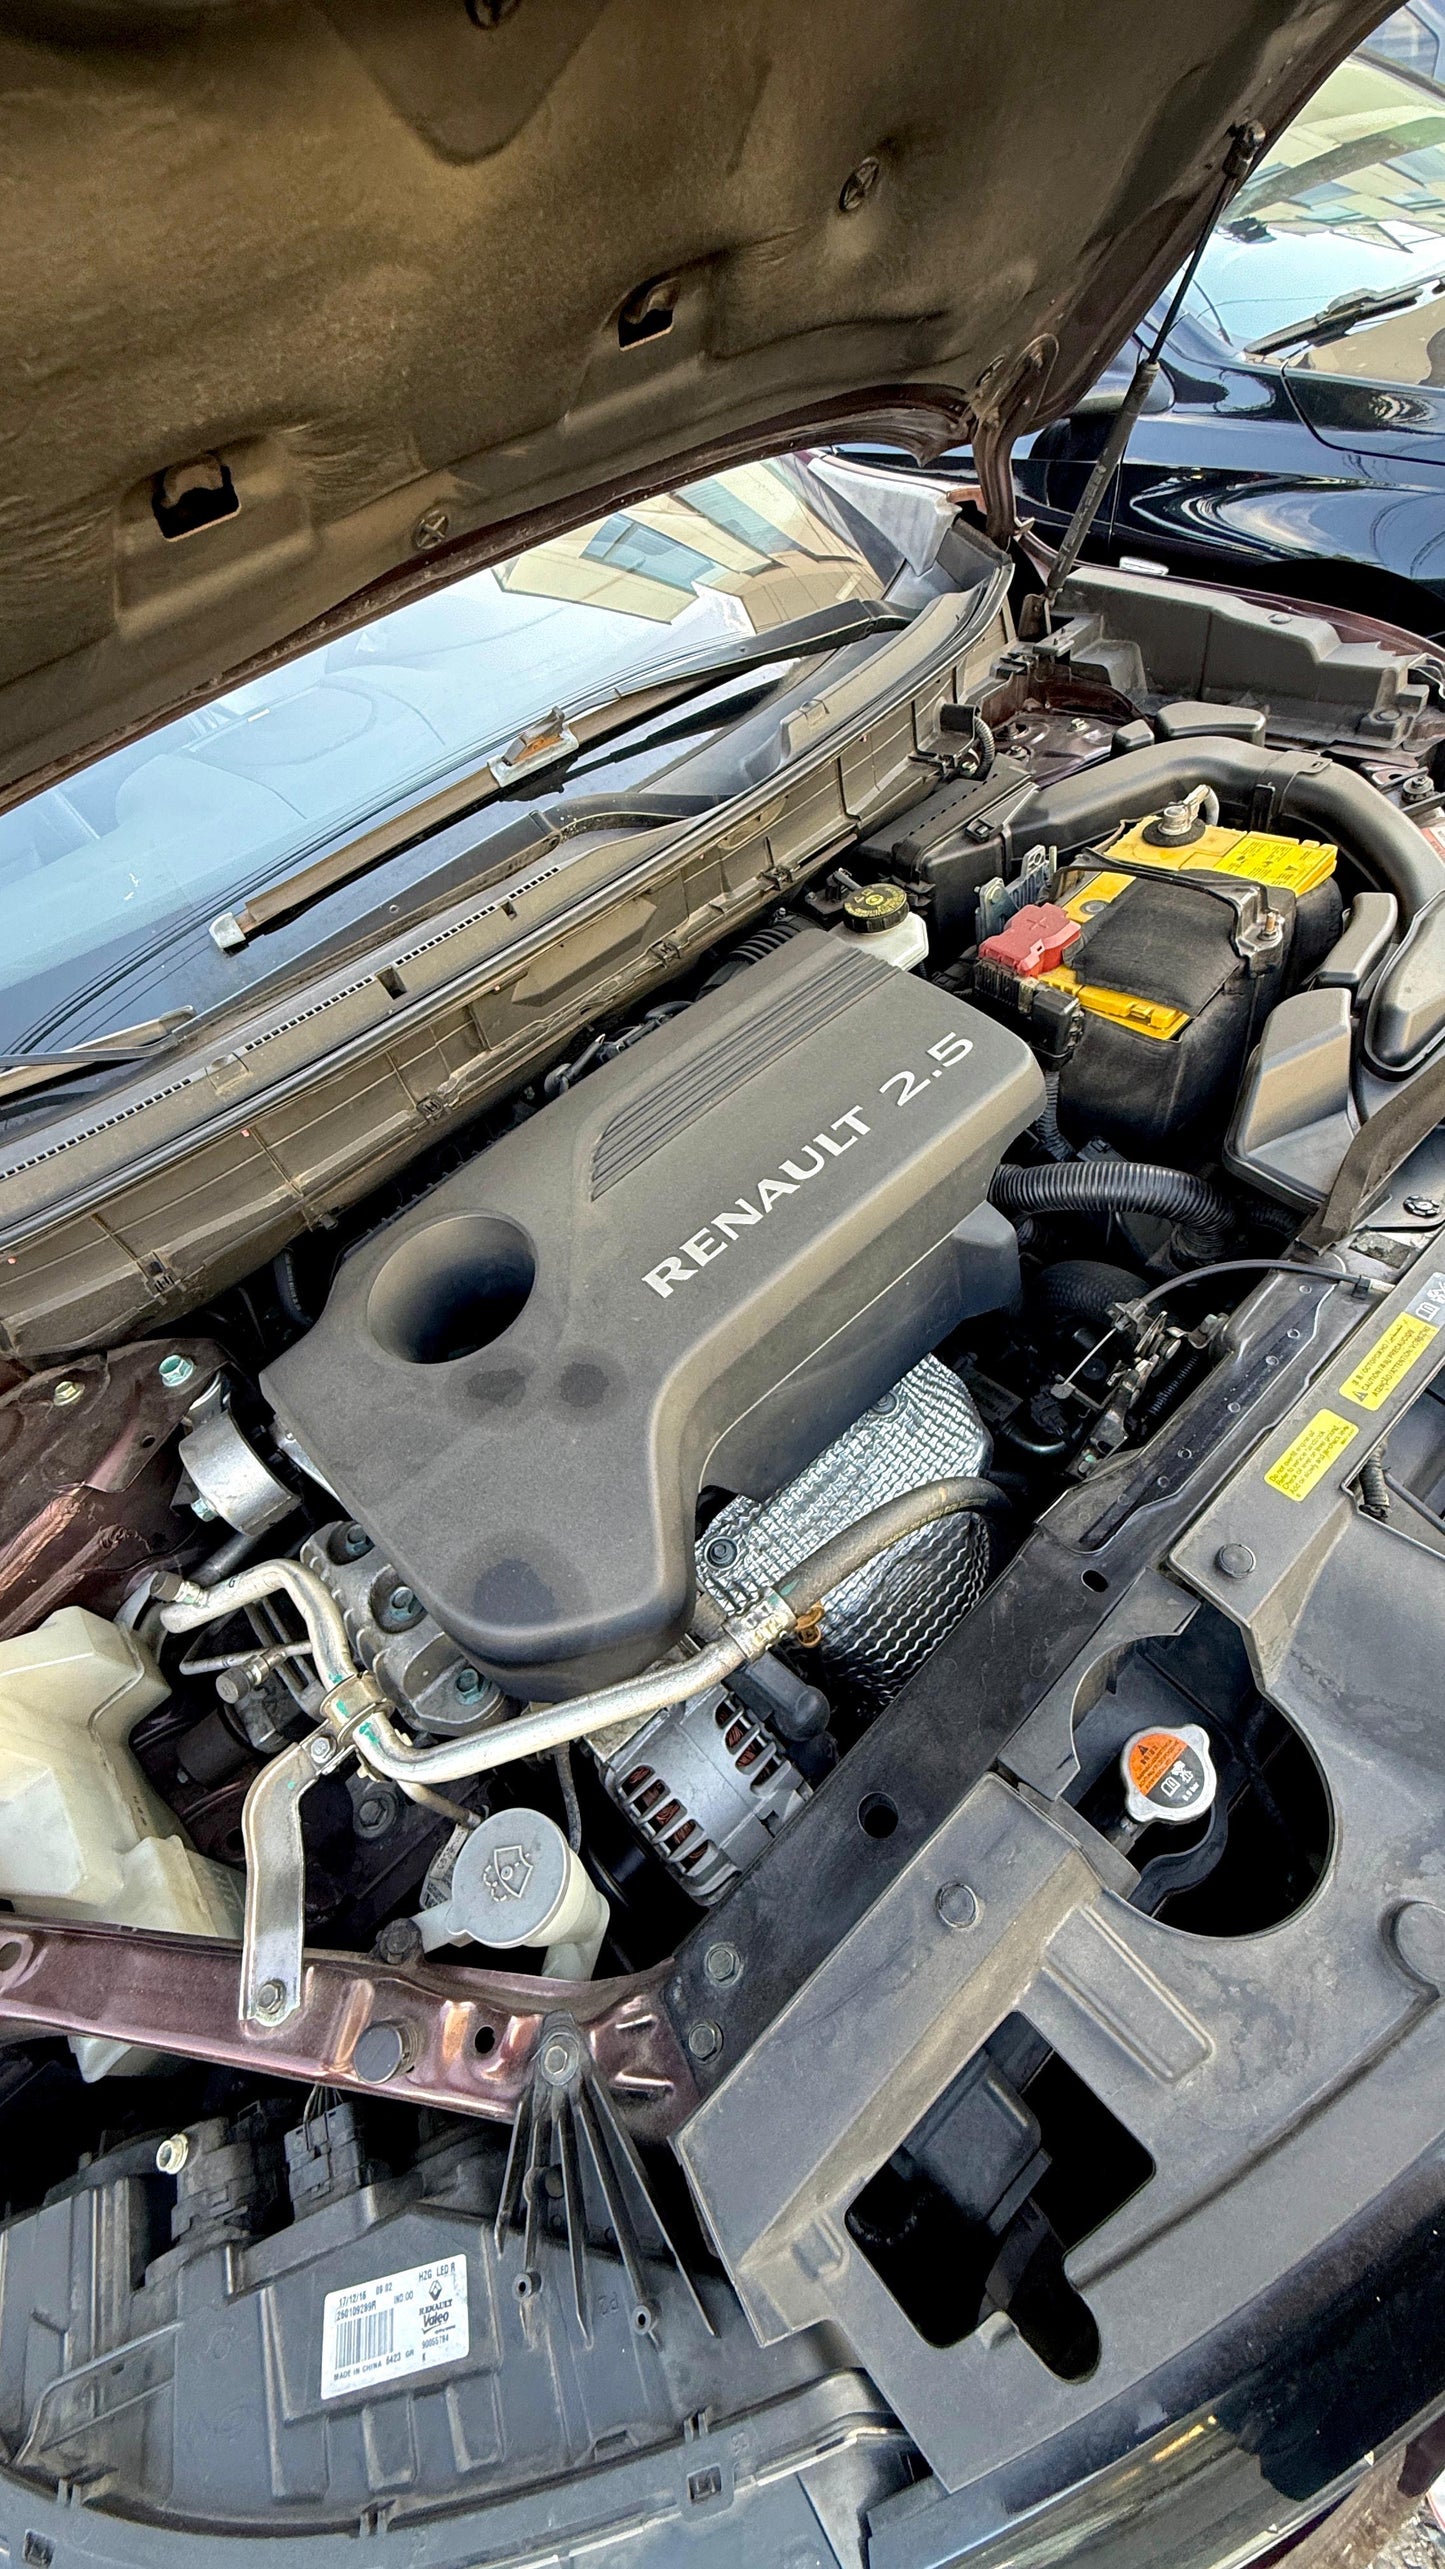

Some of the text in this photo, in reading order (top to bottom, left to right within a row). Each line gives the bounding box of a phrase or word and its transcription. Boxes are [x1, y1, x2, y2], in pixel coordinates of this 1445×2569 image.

[641, 1032, 974, 1299] RENAULT 2.5
[419, 2299, 453, 2315] RENAULT
[334, 2369, 351, 2381] MADE
[353, 2366, 360, 2375] IN
[362, 2361, 382, 2373] CHINA
